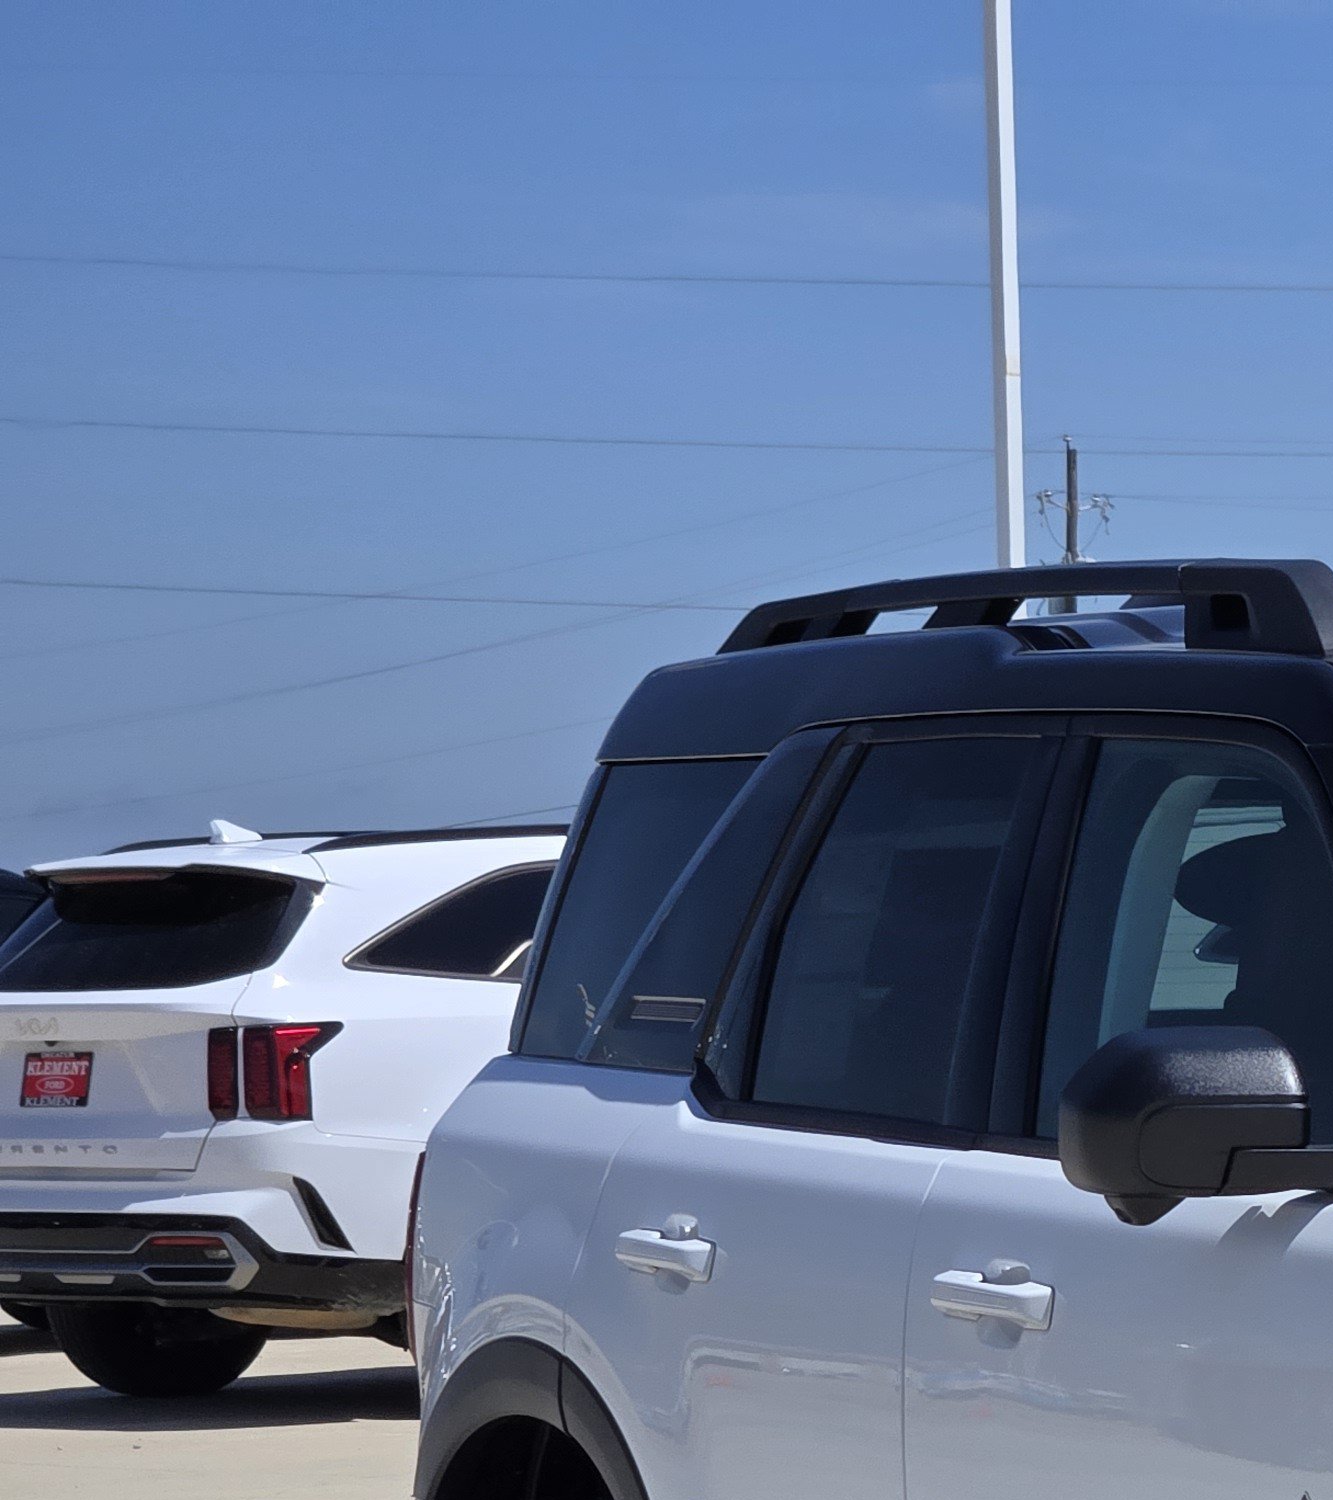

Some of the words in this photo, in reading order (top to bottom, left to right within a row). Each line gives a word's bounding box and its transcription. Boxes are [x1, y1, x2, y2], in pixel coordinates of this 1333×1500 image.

[26, 1060, 90, 1076] KLEMENT
[44, 1080, 66, 1090] FORD
[23, 1095, 80, 1107] KLEMENT
[0, 1144, 118, 1155] RENTO
